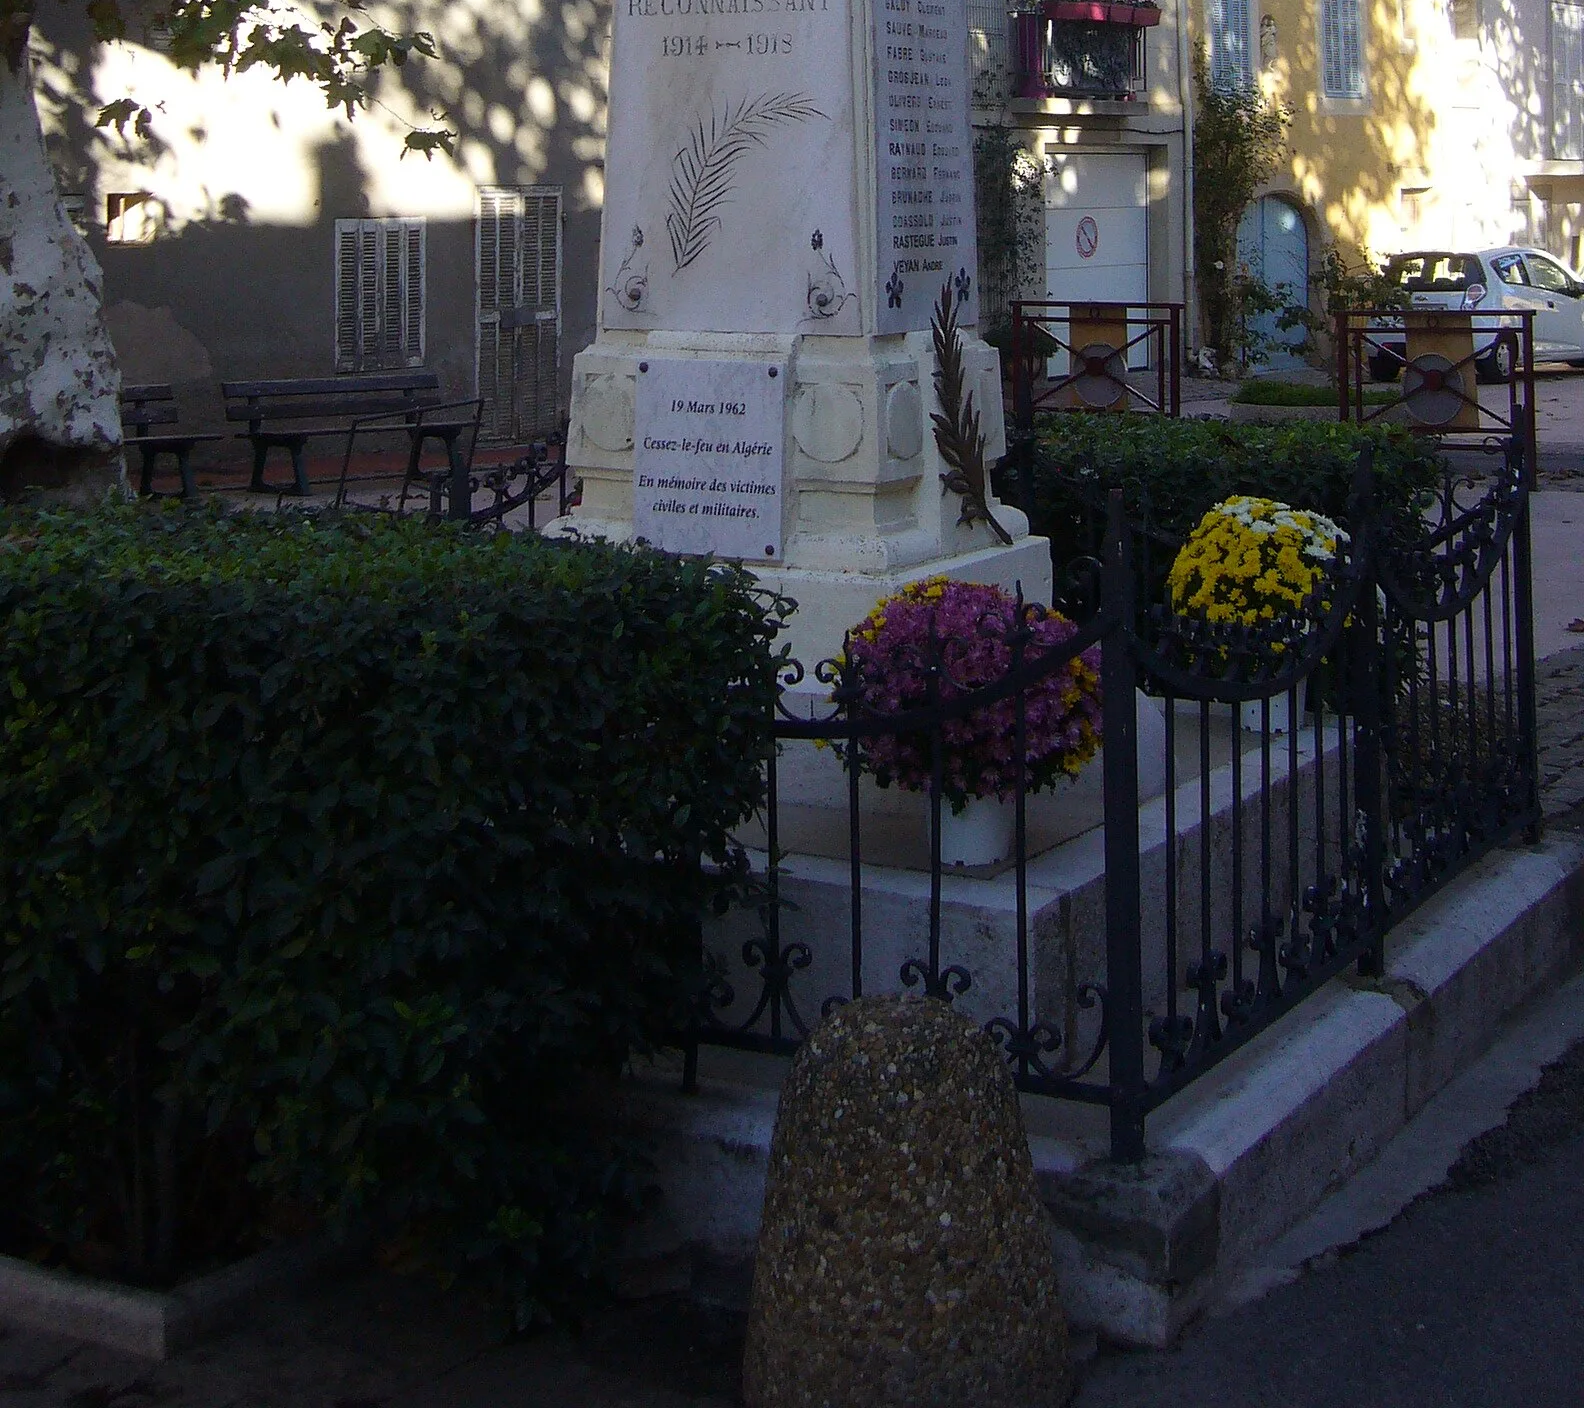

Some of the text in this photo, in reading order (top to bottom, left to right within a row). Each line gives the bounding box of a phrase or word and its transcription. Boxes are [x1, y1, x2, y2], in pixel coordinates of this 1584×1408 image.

[661, 32, 794, 57] 1914 1918
[887, 46, 913, 61] FABRE
[888, 70, 929, 85] GROSJEAN
[889, 142, 926, 156] RAYNAUD
[891, 167, 927, 180] BERNARD
[893, 234, 935, 249] RASTEGUE
[893, 259, 920, 273] VEYAN
[670, 399, 747, 416] 19 Mars 1962
[643, 436, 774, 459] Cessez-le-feu en Algérie
[638, 474, 777, 497] En mémoire des victimes
[652, 499, 761, 520] civiles et militaires.
